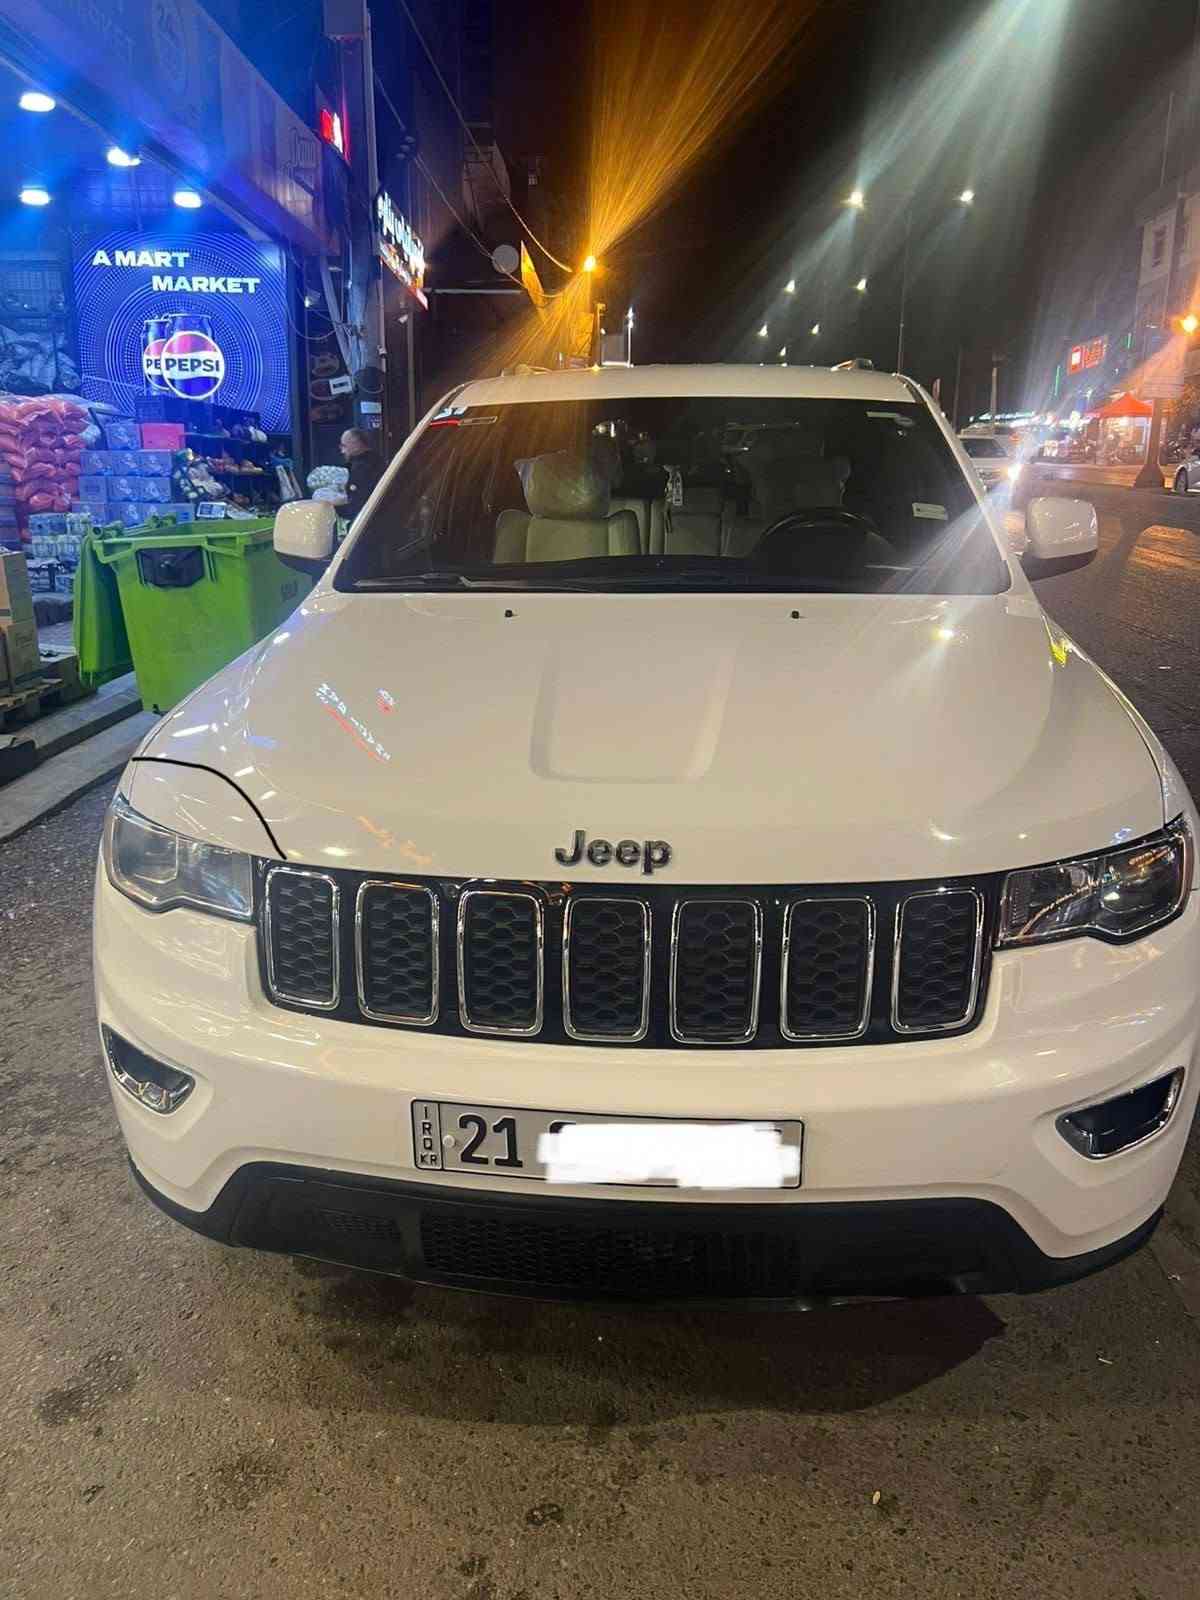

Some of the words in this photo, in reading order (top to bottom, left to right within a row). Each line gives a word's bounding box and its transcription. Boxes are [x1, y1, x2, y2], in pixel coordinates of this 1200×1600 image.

[92, 250, 112, 266] A
[115, 251, 190, 268] MART
[152, 275, 260, 294] MARKET
[164, 357, 220, 372] PEPSI
[554, 829, 673, 875] Jeep
[458, 1113, 523, 1168] 21
[420, 1153, 438, 1166] KR
